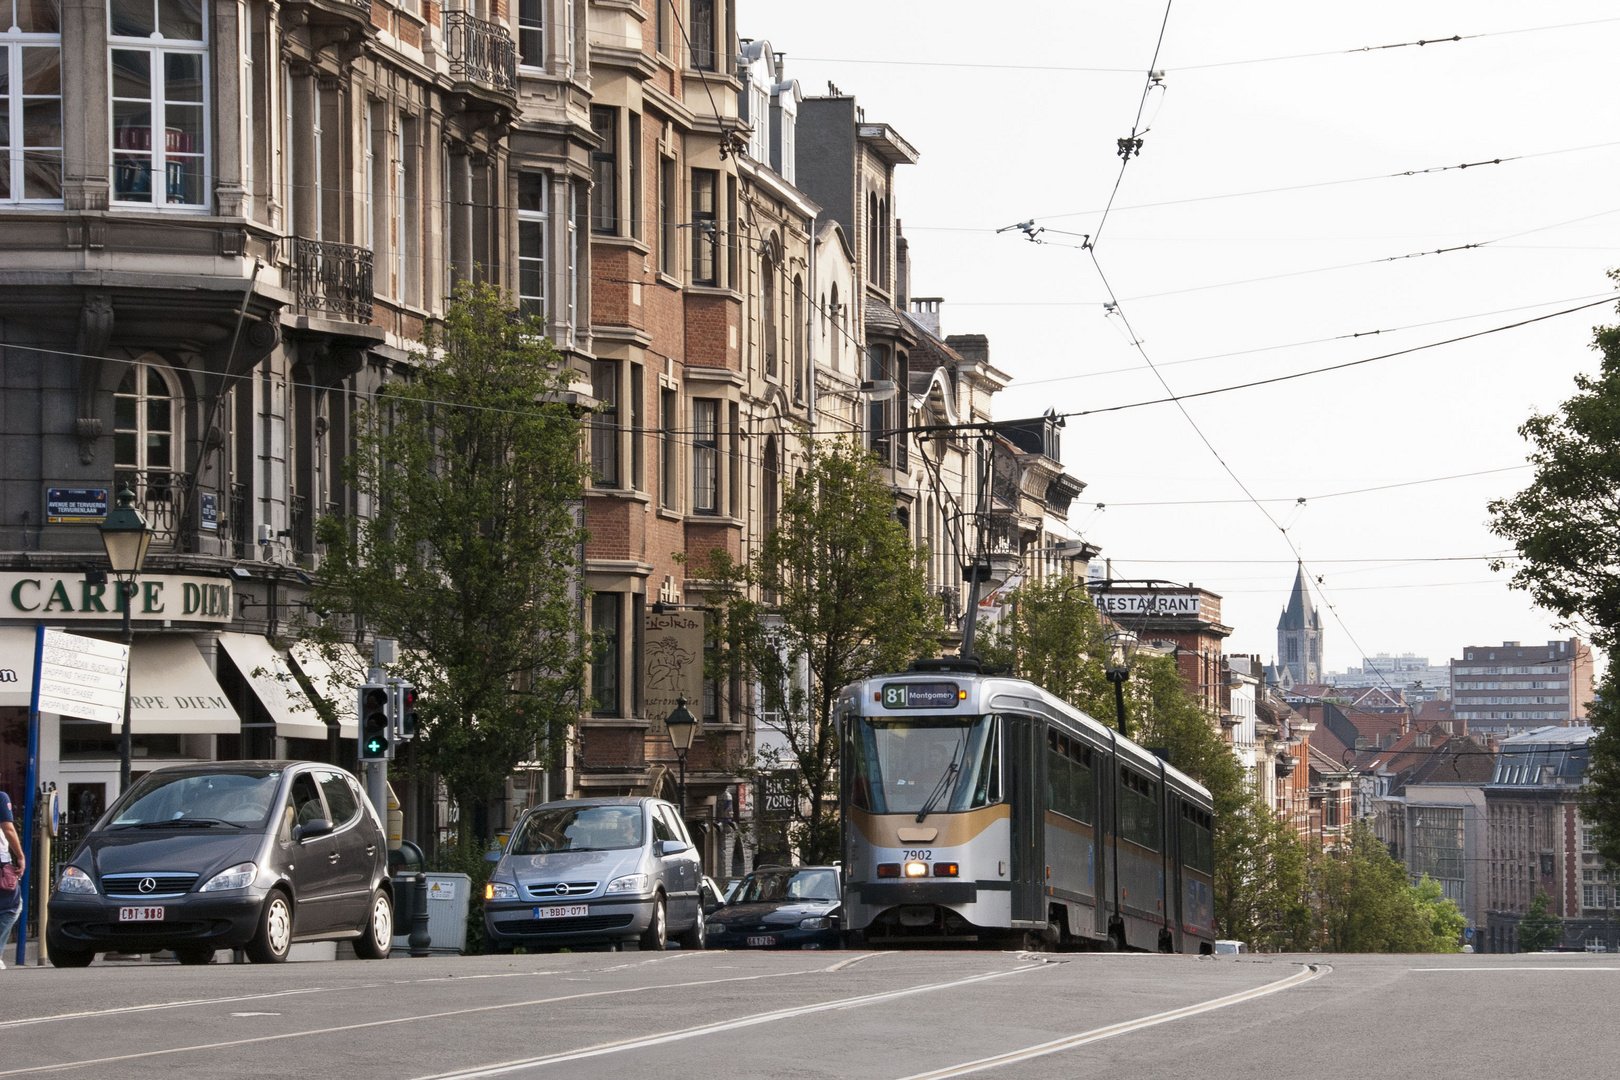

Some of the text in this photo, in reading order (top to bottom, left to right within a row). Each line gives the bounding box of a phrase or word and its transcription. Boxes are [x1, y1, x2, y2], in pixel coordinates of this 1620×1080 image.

[11, 579, 230, 617] CARPE DIEM
[1096, 597, 1199, 610] RESTAURANT
[887, 688, 954, 703] 81 Montgomery
[174, 696, 227, 709] DIEM
[42, 781, 56, 793] 13
[903, 850, 932, 860] 7902
[540, 906, 587, 918] 1-BBD-071
